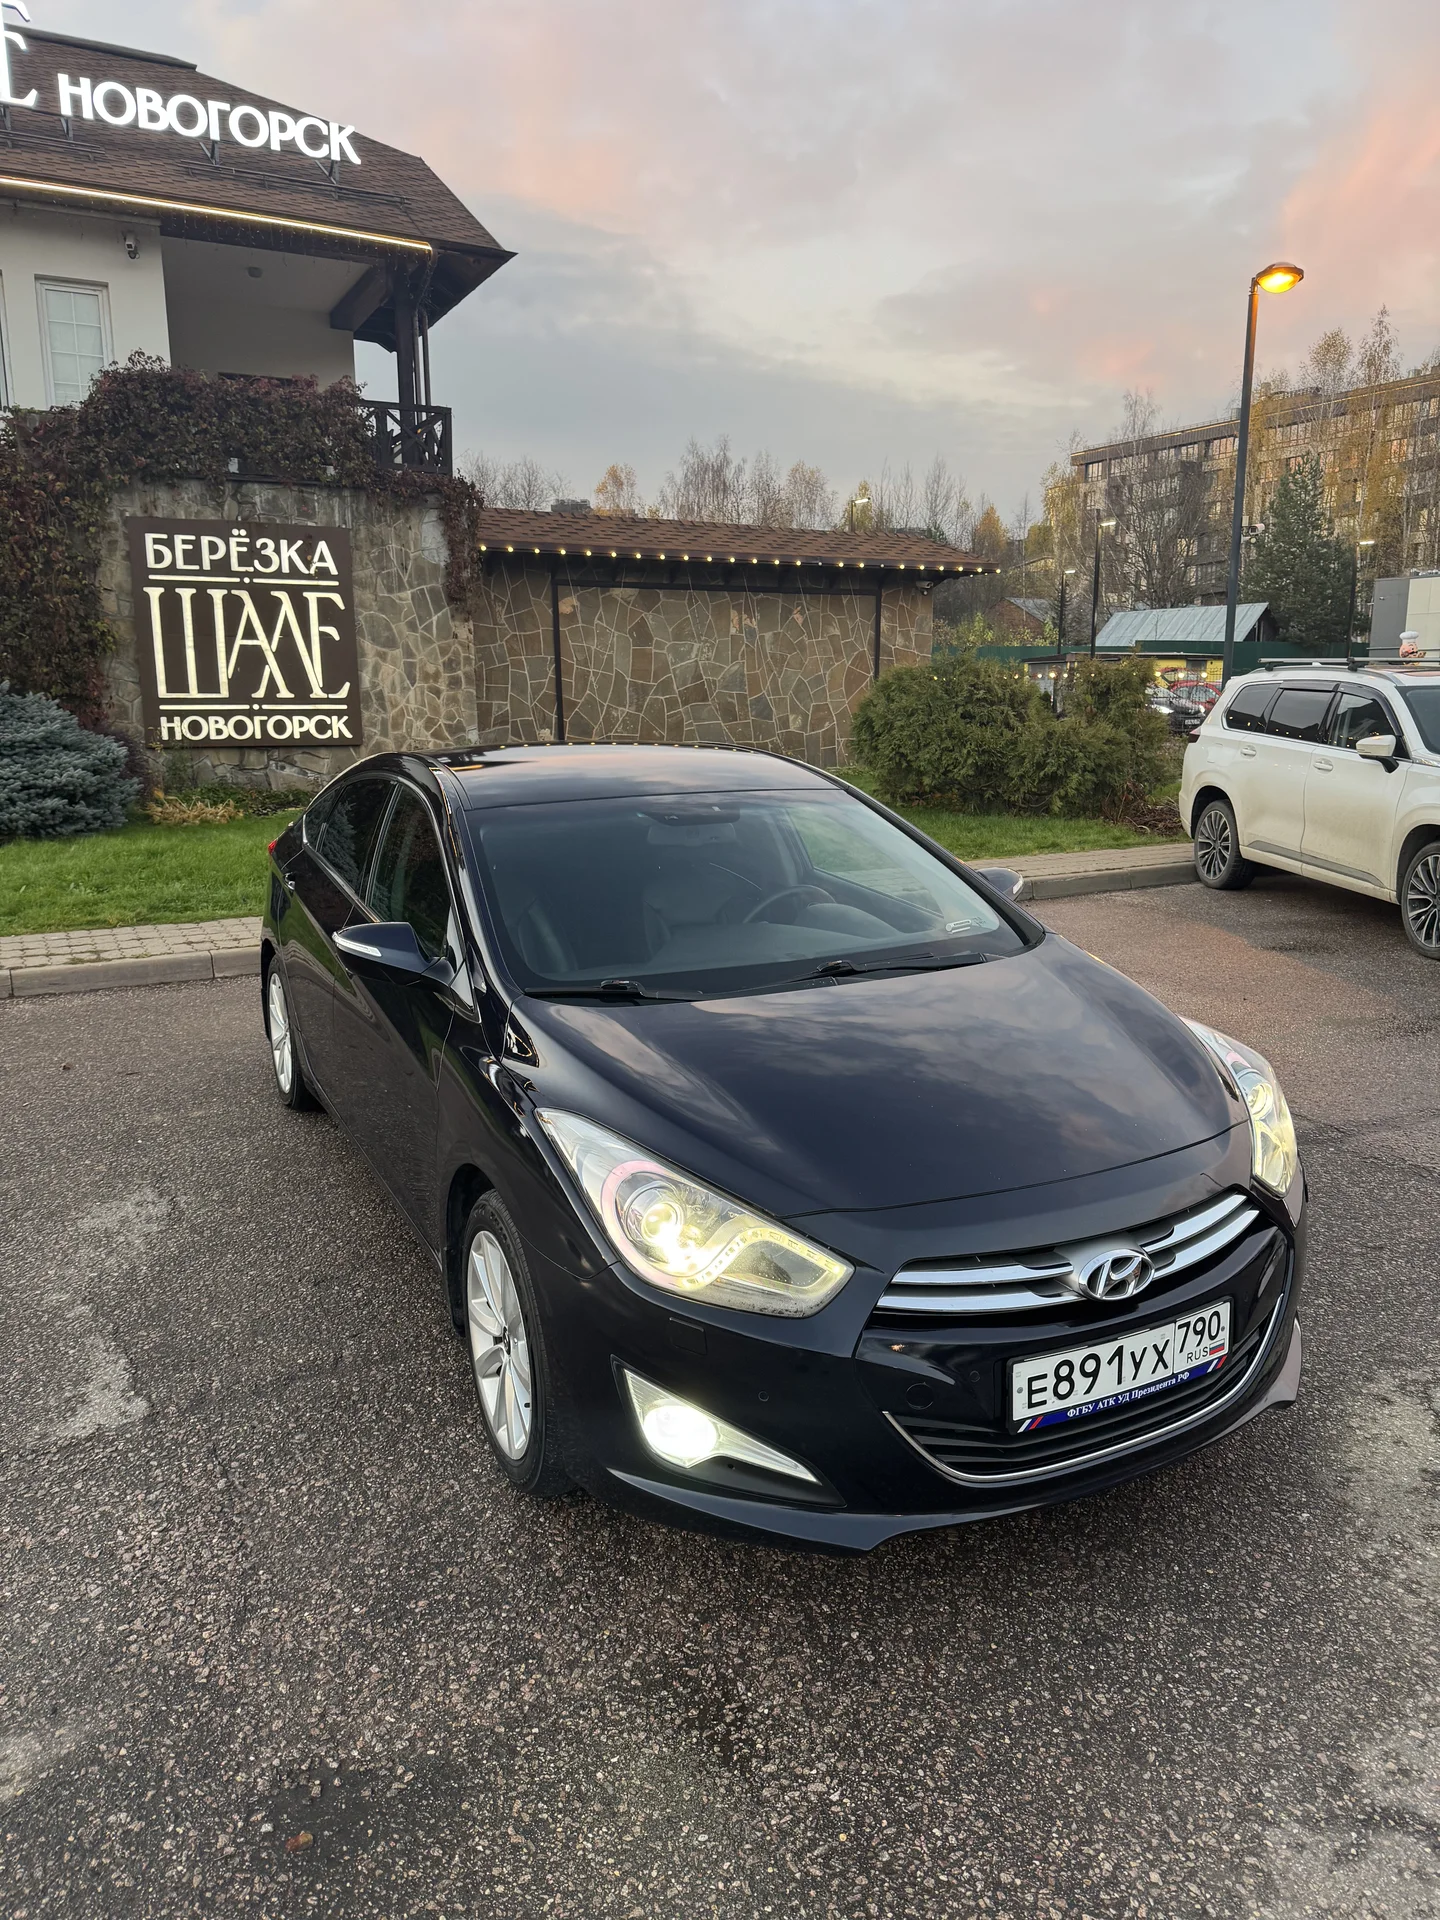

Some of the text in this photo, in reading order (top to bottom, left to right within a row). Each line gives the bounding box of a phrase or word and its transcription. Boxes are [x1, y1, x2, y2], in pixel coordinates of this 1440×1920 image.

[57, 73, 361, 165] НОВОГОРСК
[144, 528, 339, 576] БЕРЁЗКА
[143, 587, 350, 698] ШАЛЕ
[159, 715, 353, 740] НОВОГОРСК
[1177, 1310, 1221, 1354] 790
[1186, 1346, 1209, 1364] RUS
[1067, 1371, 1190, 1417] ФГБУ АТК УД Президента РФ
